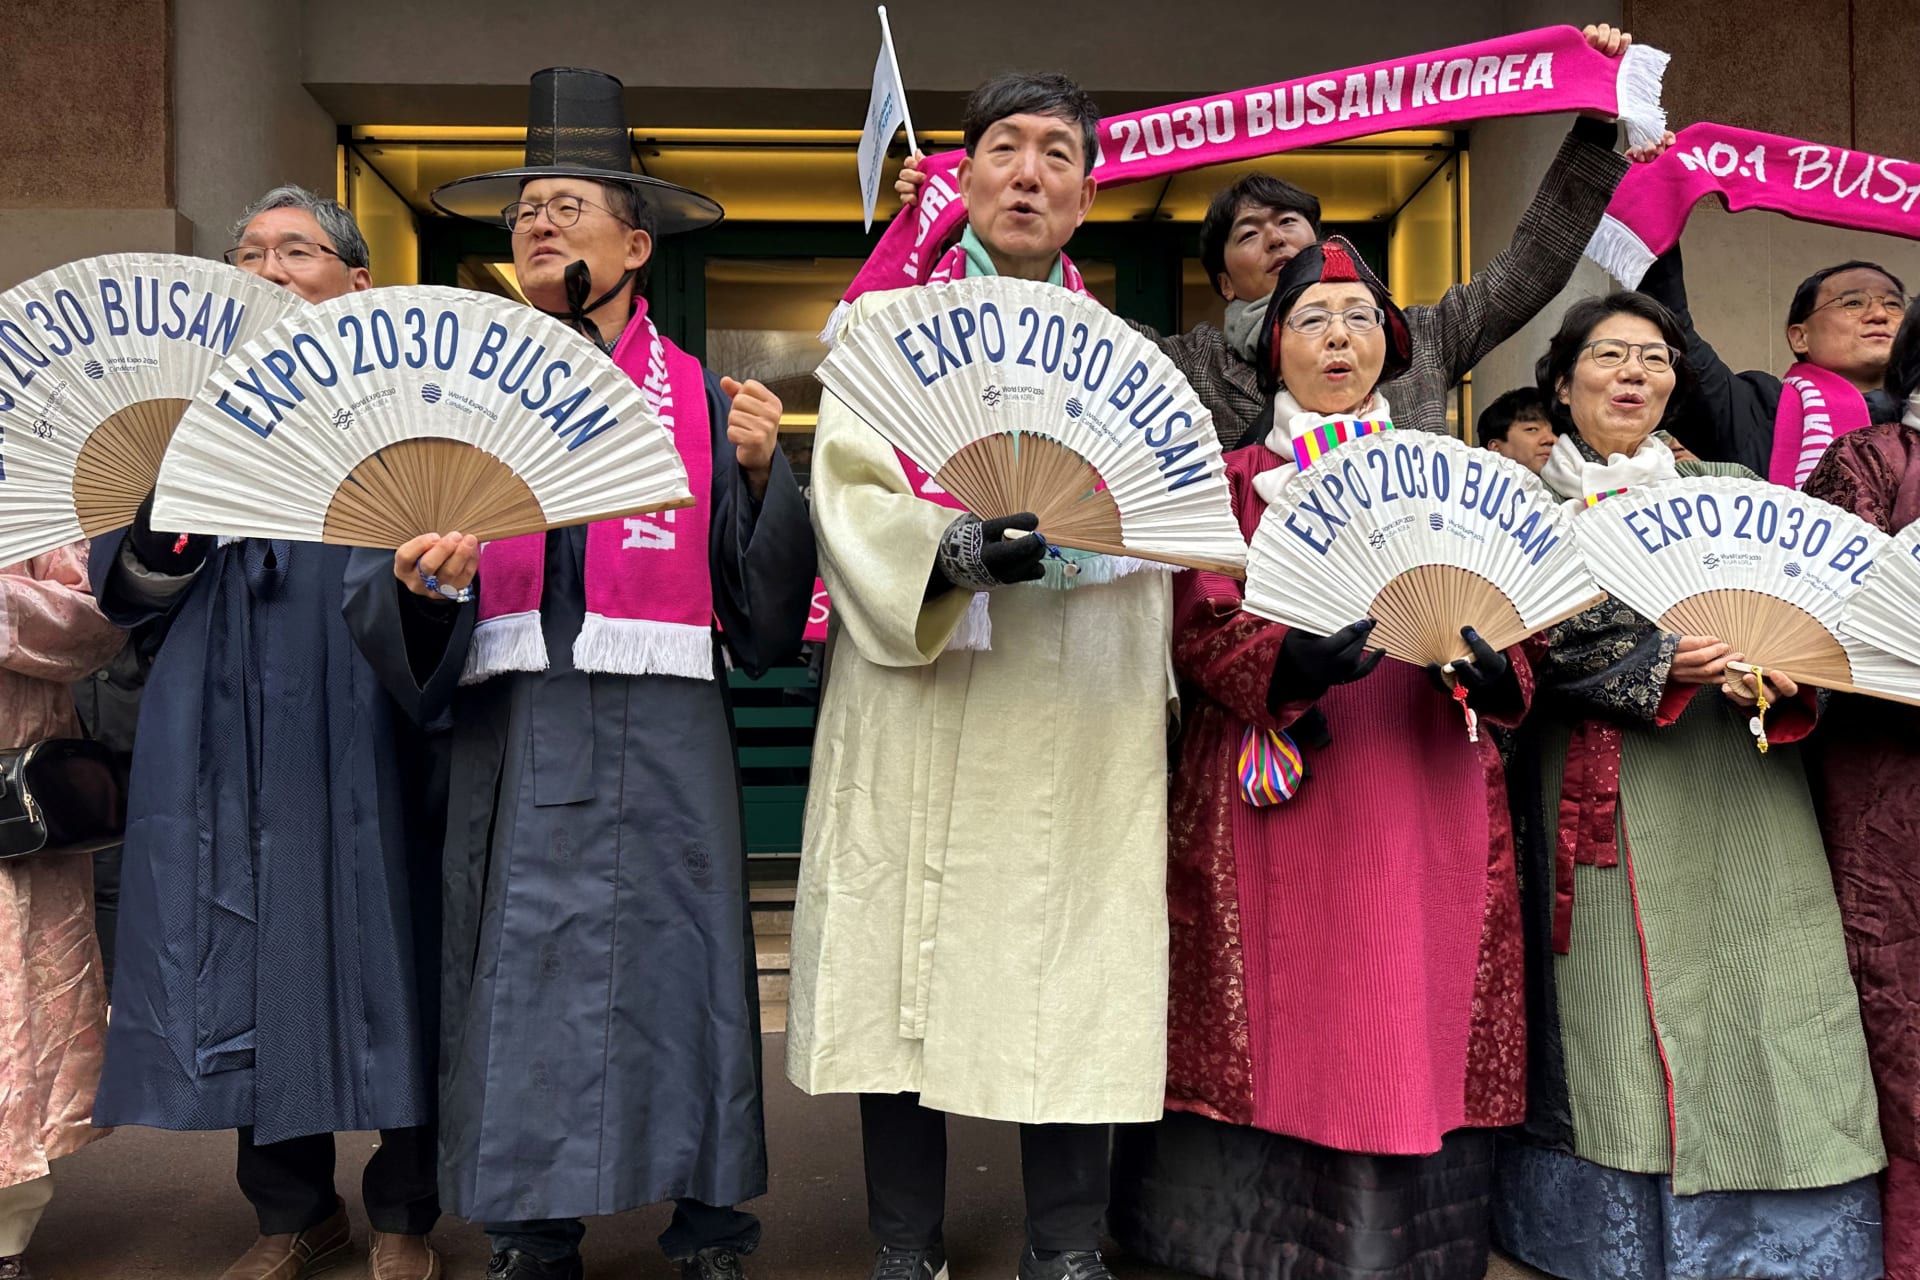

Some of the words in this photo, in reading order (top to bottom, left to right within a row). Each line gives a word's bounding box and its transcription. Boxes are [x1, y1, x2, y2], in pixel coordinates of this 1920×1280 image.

[1109, 100, 1236, 163] 2030
[1245, 66, 1405, 138] BUSAN
[1412, 52, 1554, 108] KOREA
[1677, 142, 1767, 183] NO.1
[99, 276, 246, 356] BUSAN
[215, 333, 339, 439] EXPO
[338, 308, 459, 376] 2030
[468, 321, 619, 452] BUSAN
[448, 390, 469, 403] World
[468, 398, 485, 411] Expo
[483, 407, 499, 421] 2030
[894, 303, 1006, 387] EXPO
[1016, 307, 1113, 391] 2030
[1108, 360, 1212, 491] BUSAN
[1285, 458, 1371, 556] EXPO
[1367, 443, 1450, 502] 2030
[1460, 461, 1560, 566] BUSAN
[1623, 494, 1722, 554] EXPO
[1734, 495, 1832, 557] 2030
